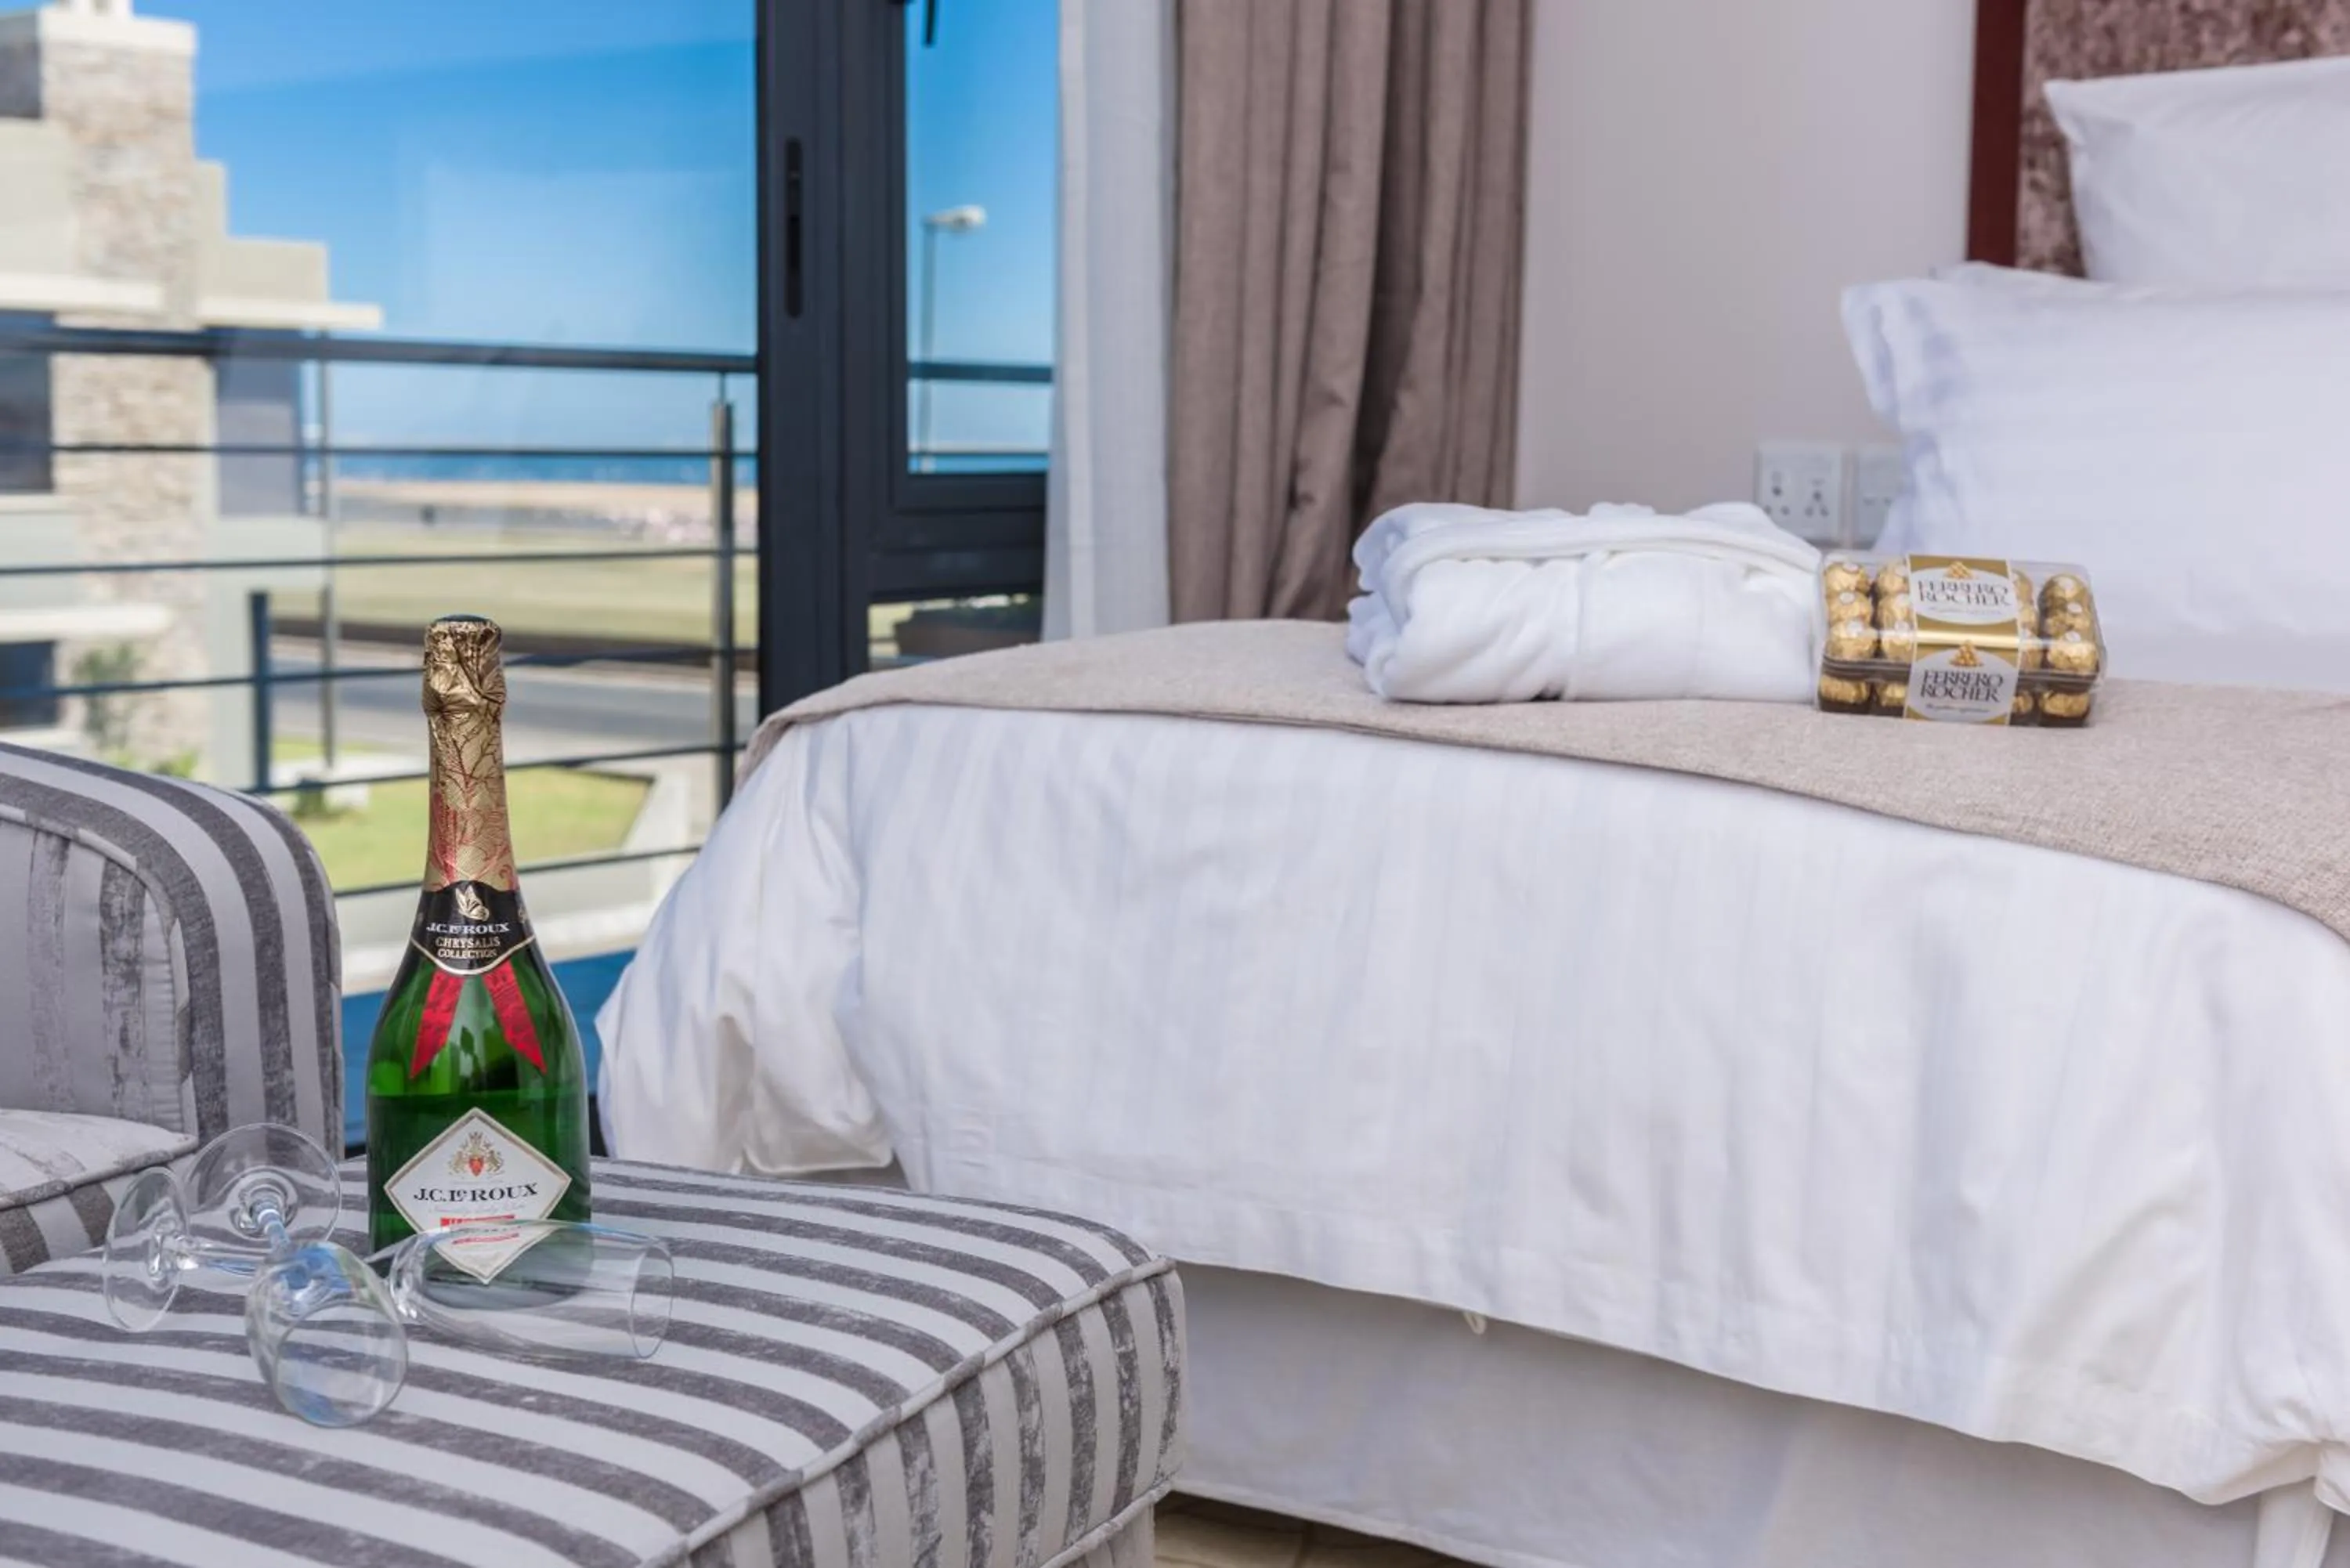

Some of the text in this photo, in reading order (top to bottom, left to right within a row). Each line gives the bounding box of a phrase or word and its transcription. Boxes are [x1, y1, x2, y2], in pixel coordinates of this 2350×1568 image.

[1918, 580, 2008, 595] FERRERO
[1918, 591, 2011, 605] ROCHER
[1922, 670, 2004, 688] FERRERO
[1920, 684, 2001, 703] ROCHER
[463, 923, 510, 934] ROUX
[435, 936, 501, 948] CHRYSALIS
[436, 948, 497, 959] COLLECTION
[470, 1183, 538, 1201] ROUX
